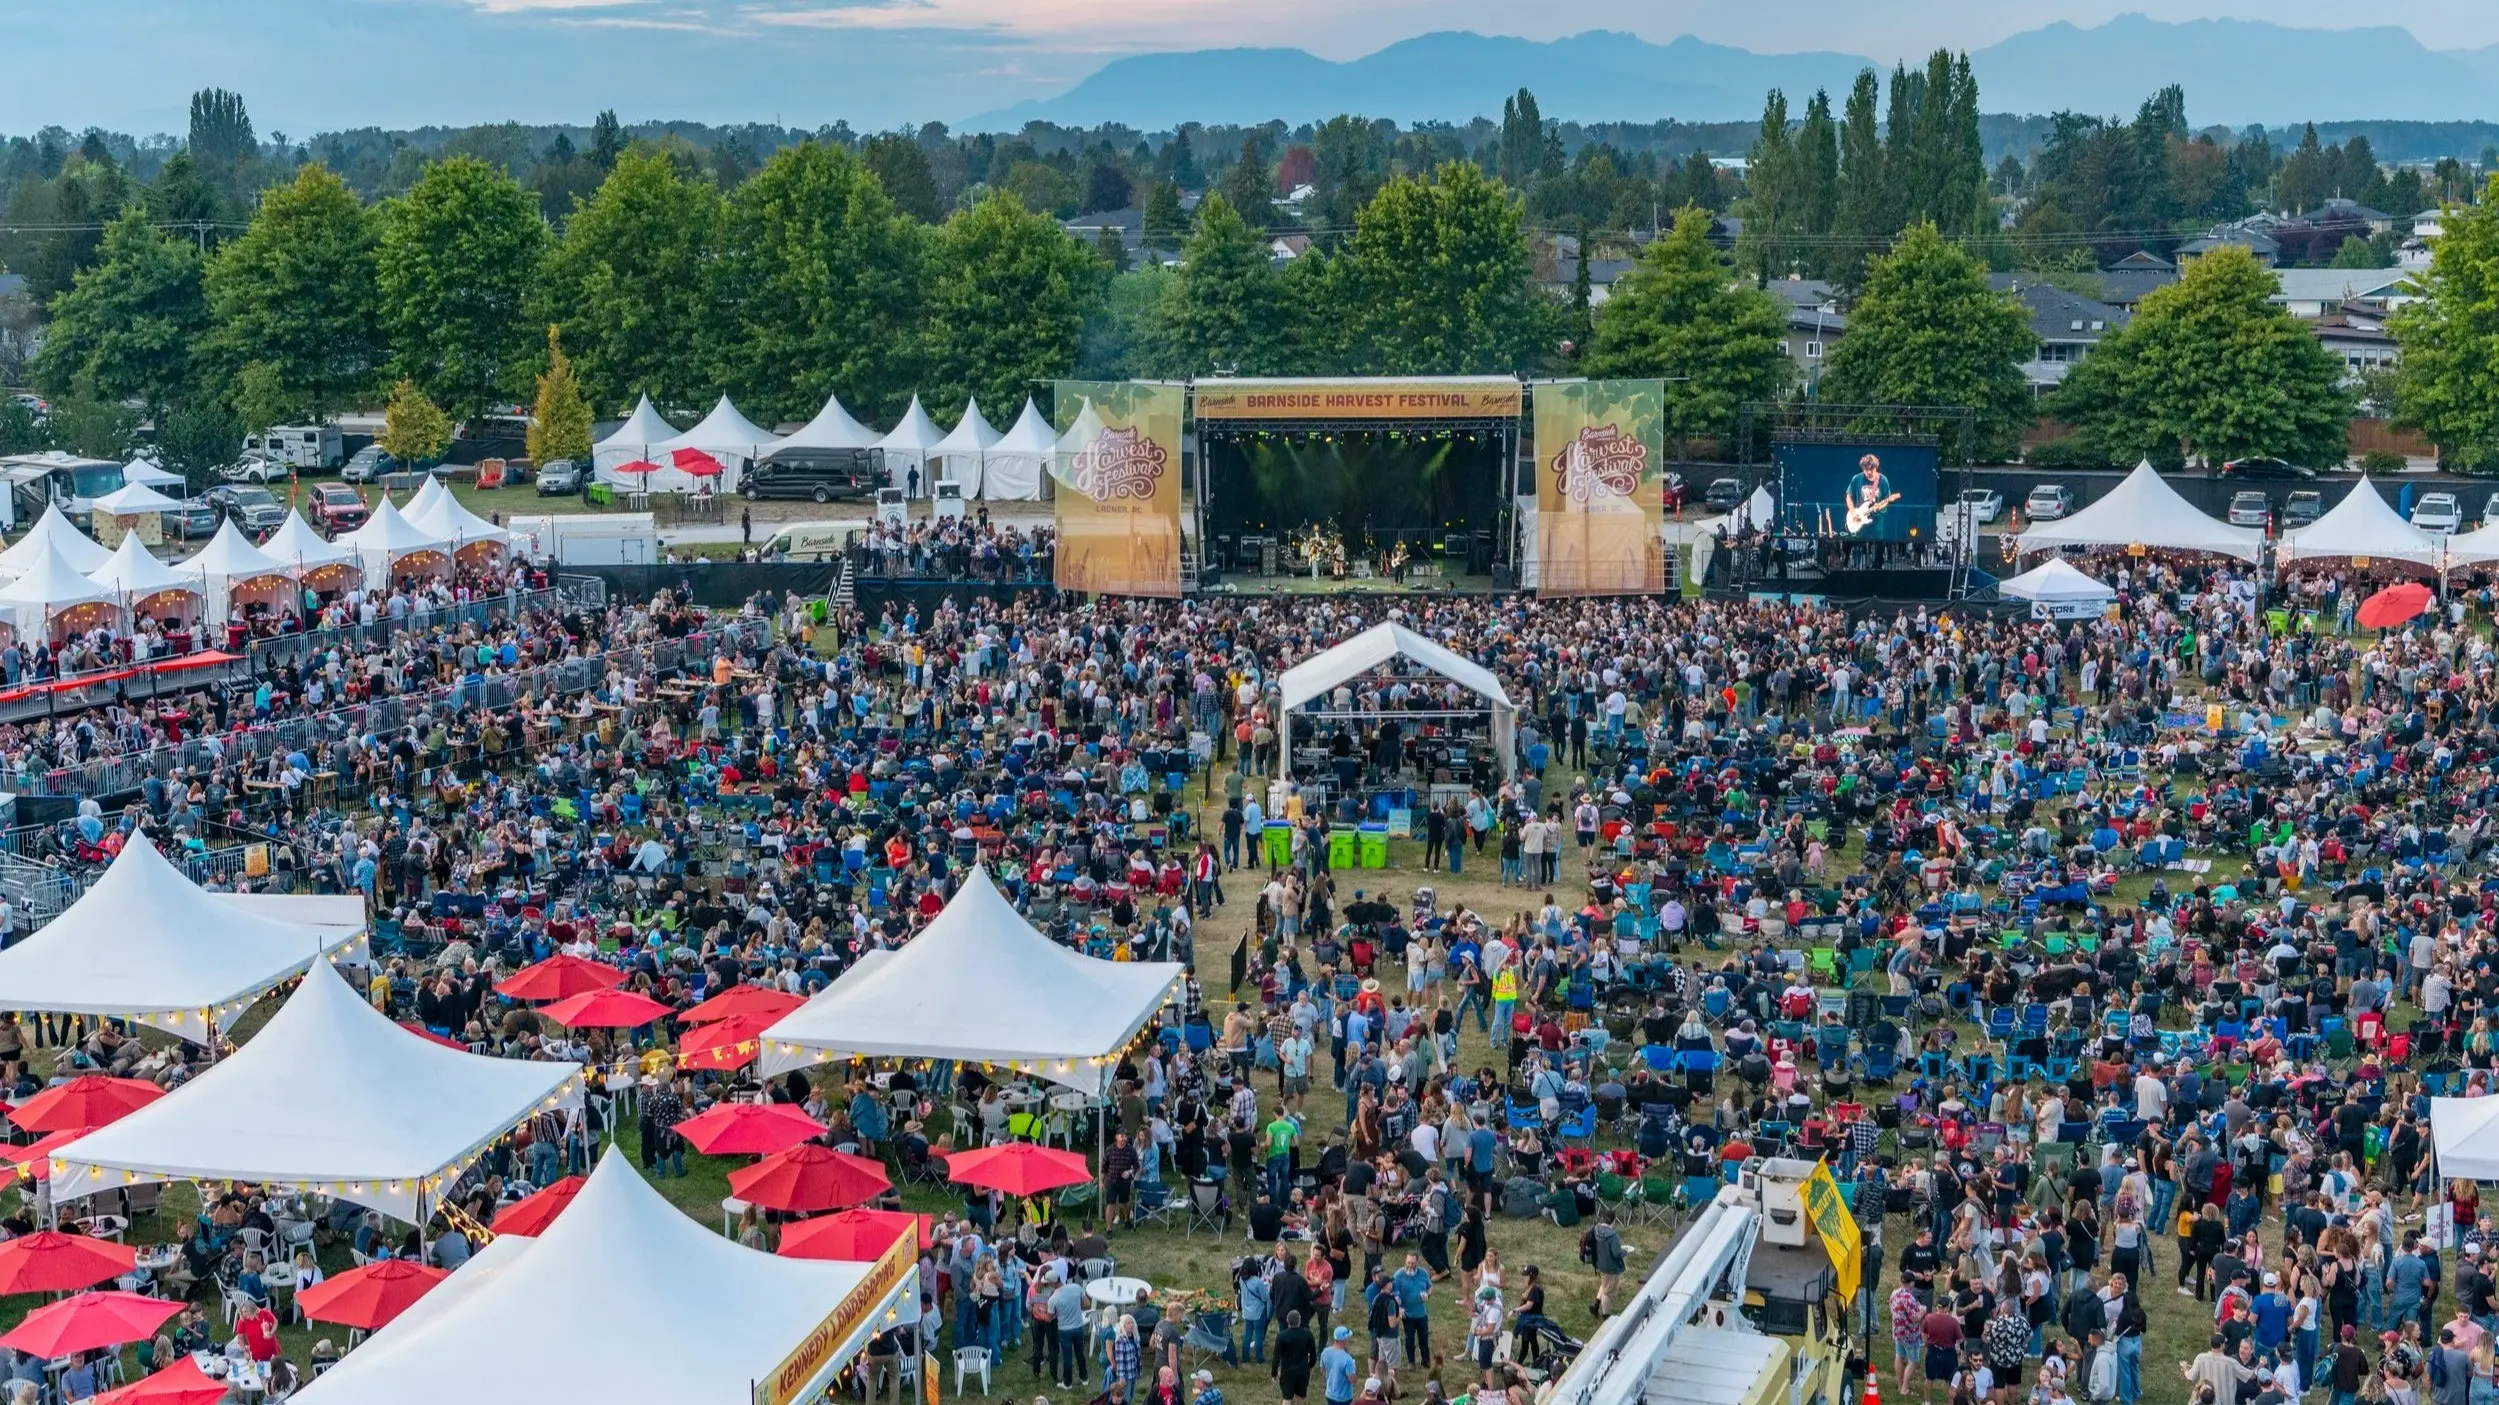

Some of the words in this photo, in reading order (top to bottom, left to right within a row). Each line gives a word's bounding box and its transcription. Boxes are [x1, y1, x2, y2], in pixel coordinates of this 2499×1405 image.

[1247, 394, 1320, 407] BARNSIDE
[1326, 394, 1393, 407] HARVEST
[1399, 394, 1469, 407] FESTIVAL
[1072, 438, 1158, 494] Harvest
[1093, 460, 1162, 501] Festival
[1552, 436, 1638, 493] Harvest
[801, 533, 836, 548] Barnside
[2431, 1230, 2448, 1240] HEE
[779, 1326, 829, 1398] KENNEDY
[830, 1255, 896, 1340] LANDSCAPING
